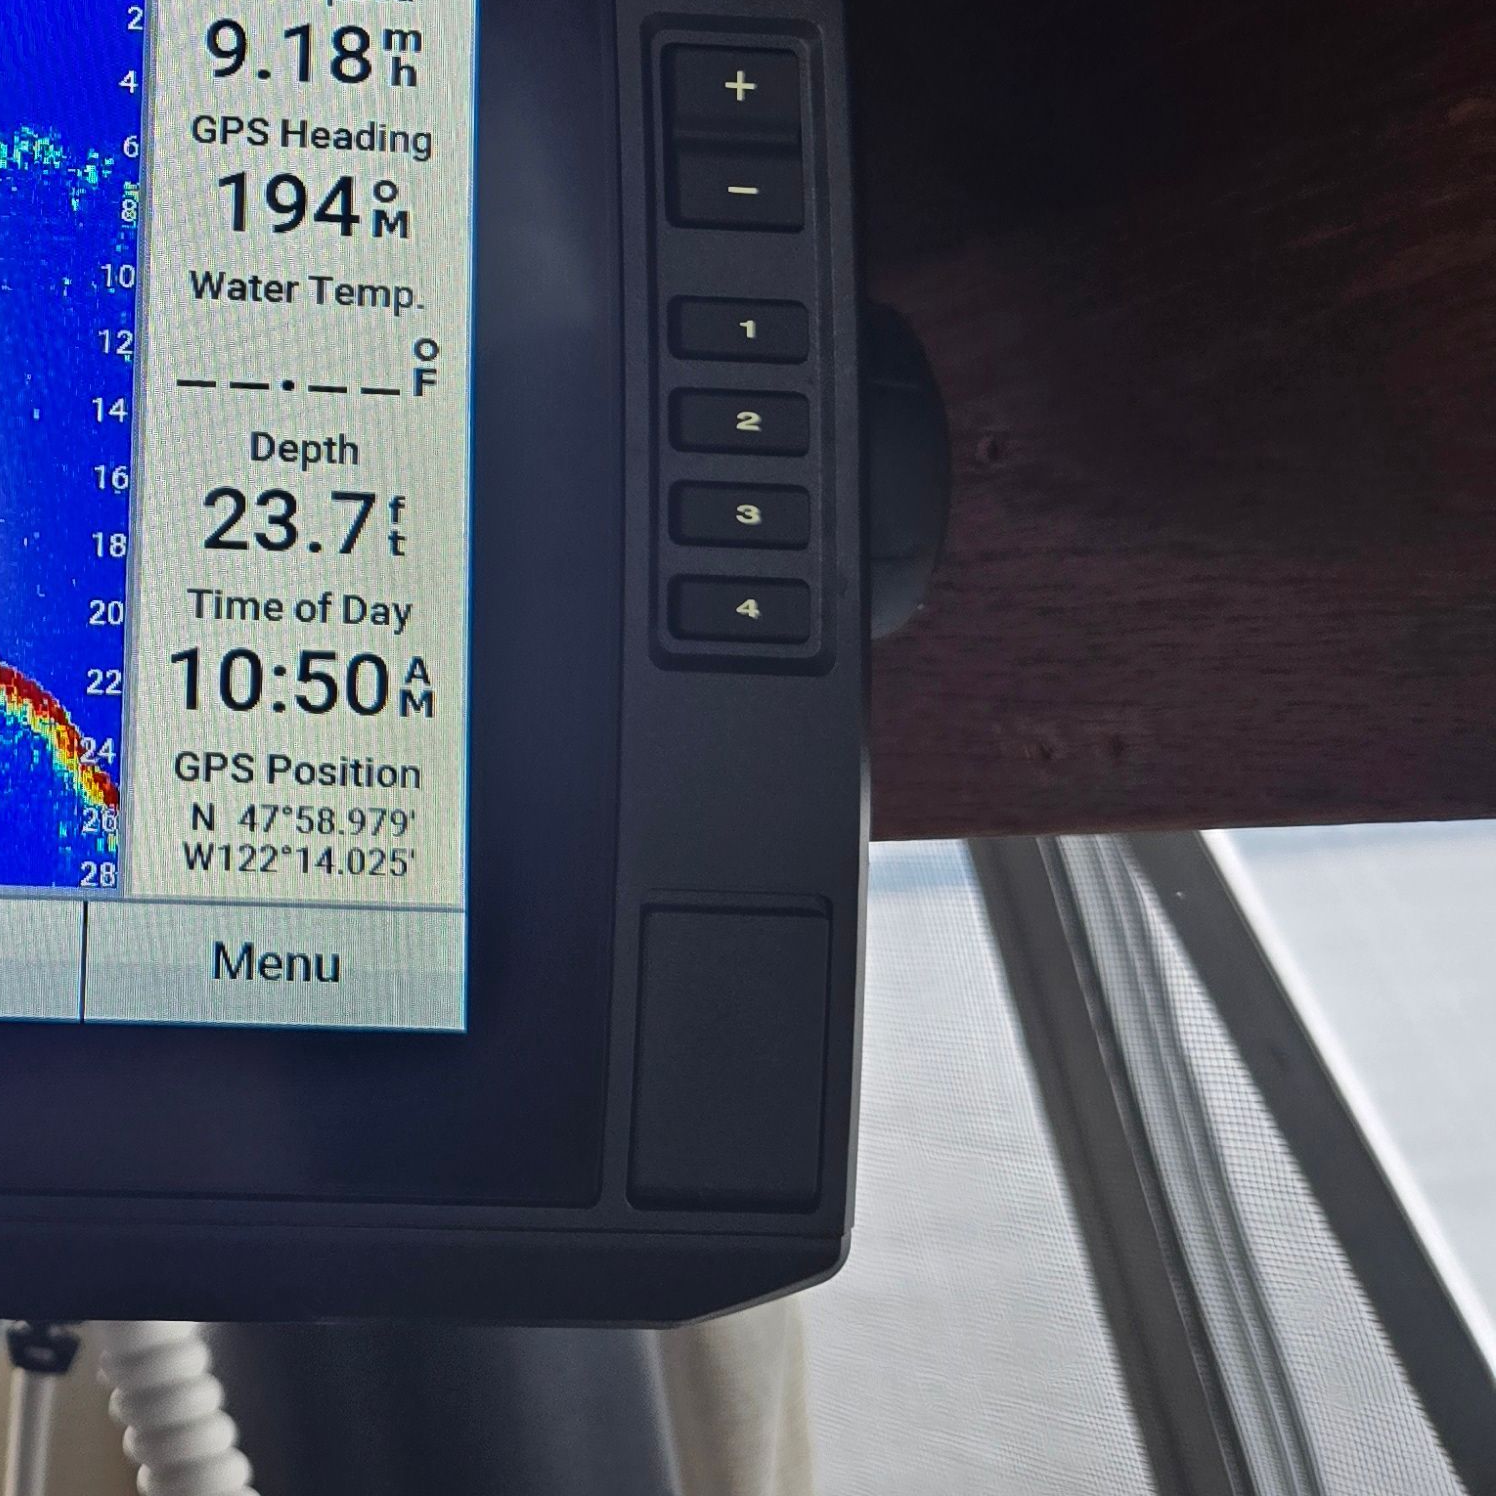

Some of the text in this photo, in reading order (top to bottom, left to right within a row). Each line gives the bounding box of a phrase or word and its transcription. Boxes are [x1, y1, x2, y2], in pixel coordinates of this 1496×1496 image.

[127, 7, 143, 30] 2
[206, 19, 372, 84] 9.18
[119, 71, 138, 93] 4
[123, 136, 139, 158] 6
[192, 115, 432, 162] GPS Heading
[218, 172, 360, 236] 194
[100, 265, 135, 288] 10
[190, 270, 424, 316] Water Temp.
[98, 329, 133, 355] 12
[739, 320, 756, 339] 1
[92, 398, 128, 423] 14
[735, 411, 762, 432] 2
[250, 431, 358, 471] Depth
[94, 465, 129, 490] 16
[203, 485, 376, 554] 23.7
[735, 504, 762, 526] 3
[92, 532, 127, 558] 18
[89, 600, 124, 625] 20
[187, 588, 413, 635] Time of Day
[735, 599, 760, 619] 4
[86, 669, 122, 695] 22
[171, 647, 389, 716] 10:50
[80, 738, 116, 764] 24
[175, 751, 421, 789] GPS Position
[80, 861, 117, 887] 28
[214, 941, 340, 982] Menu
